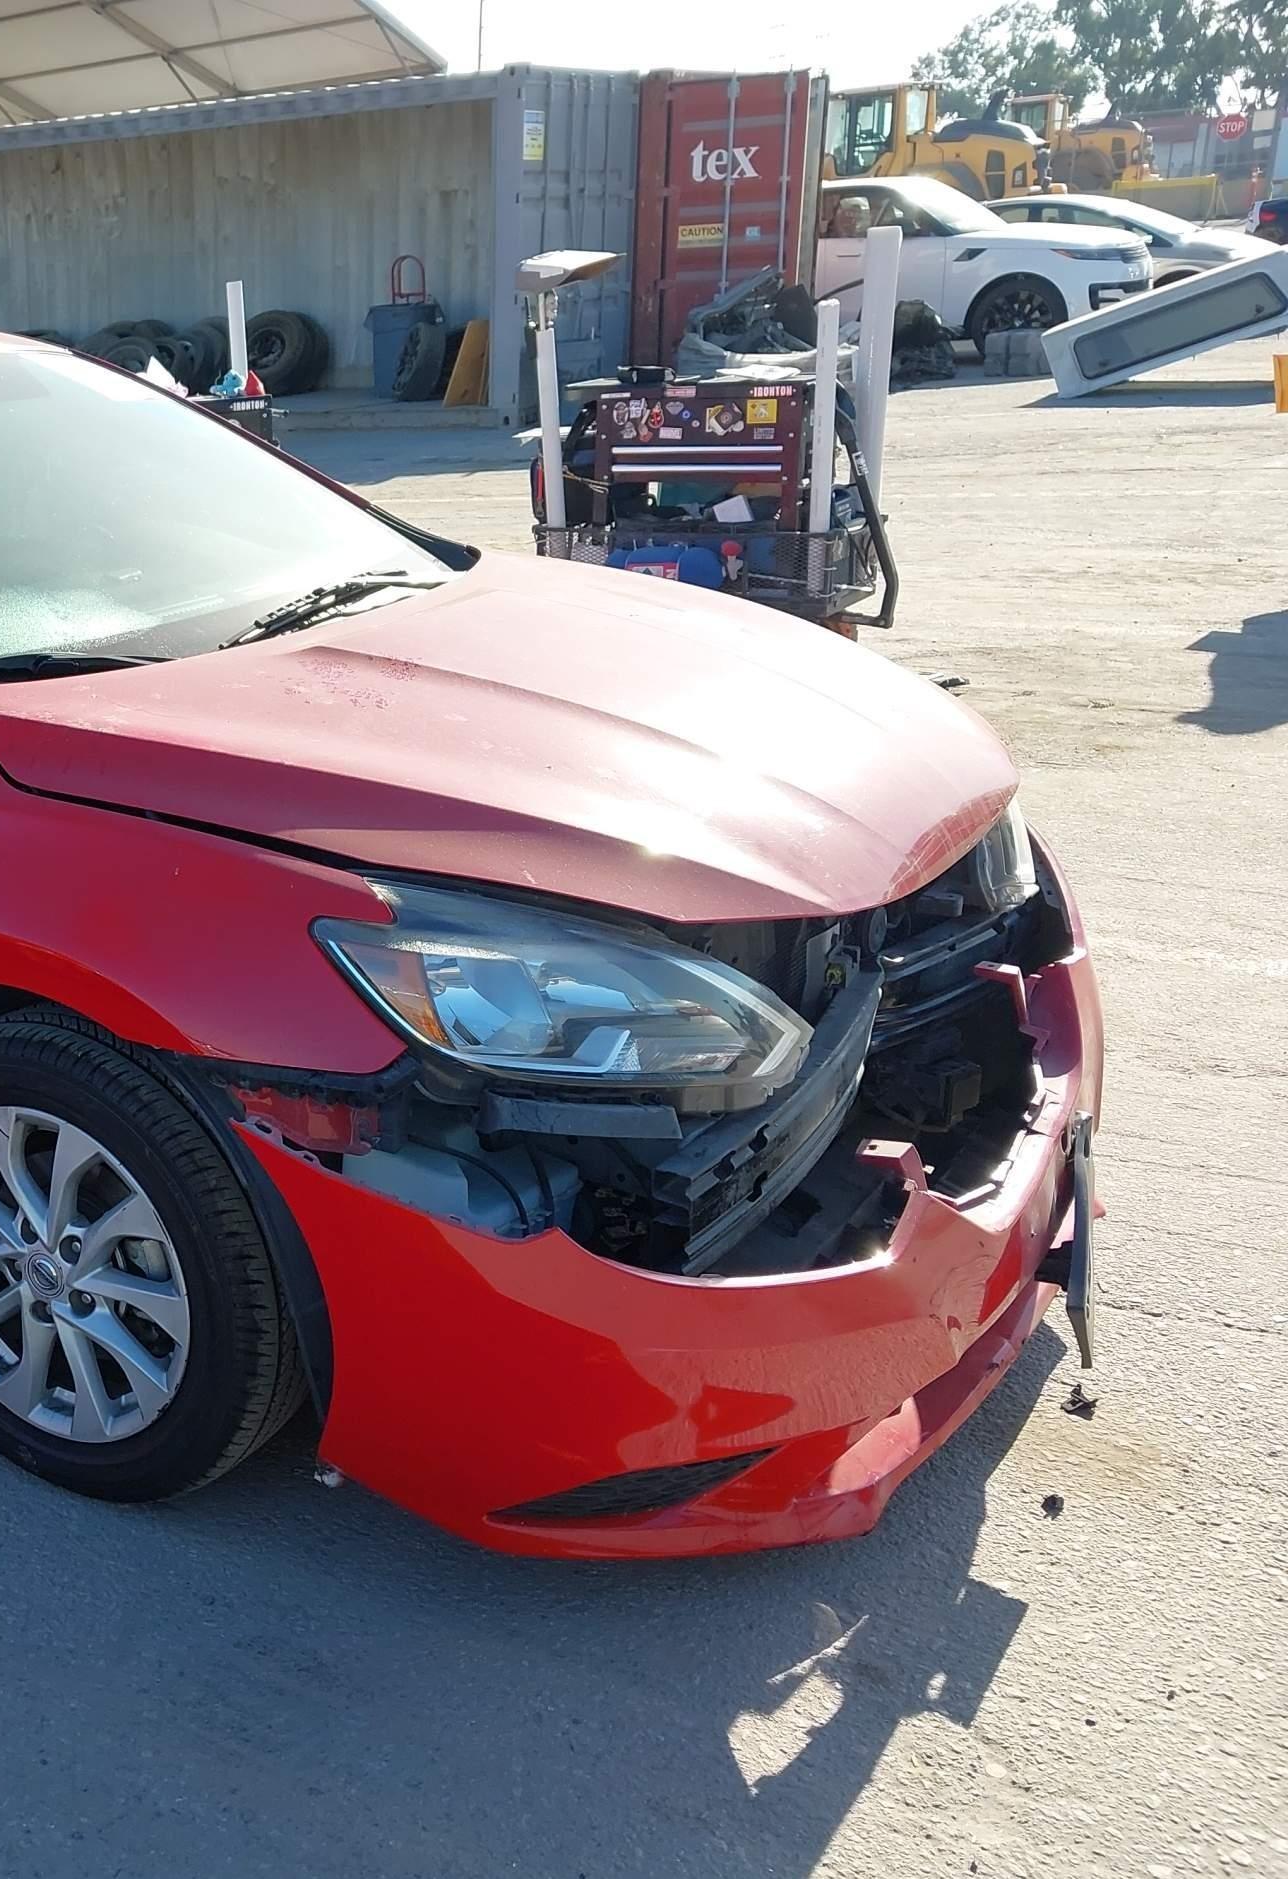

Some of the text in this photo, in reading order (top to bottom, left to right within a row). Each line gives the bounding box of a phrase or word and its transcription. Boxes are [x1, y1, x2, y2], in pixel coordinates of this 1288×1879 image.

[1218, 121, 1245, 133] STOP
[690, 140, 761, 182] tex
[681, 226, 724, 238] CAUTION
[753, 385, 792, 397] IRONTON
[233, 400, 265, 411] IRONTON
